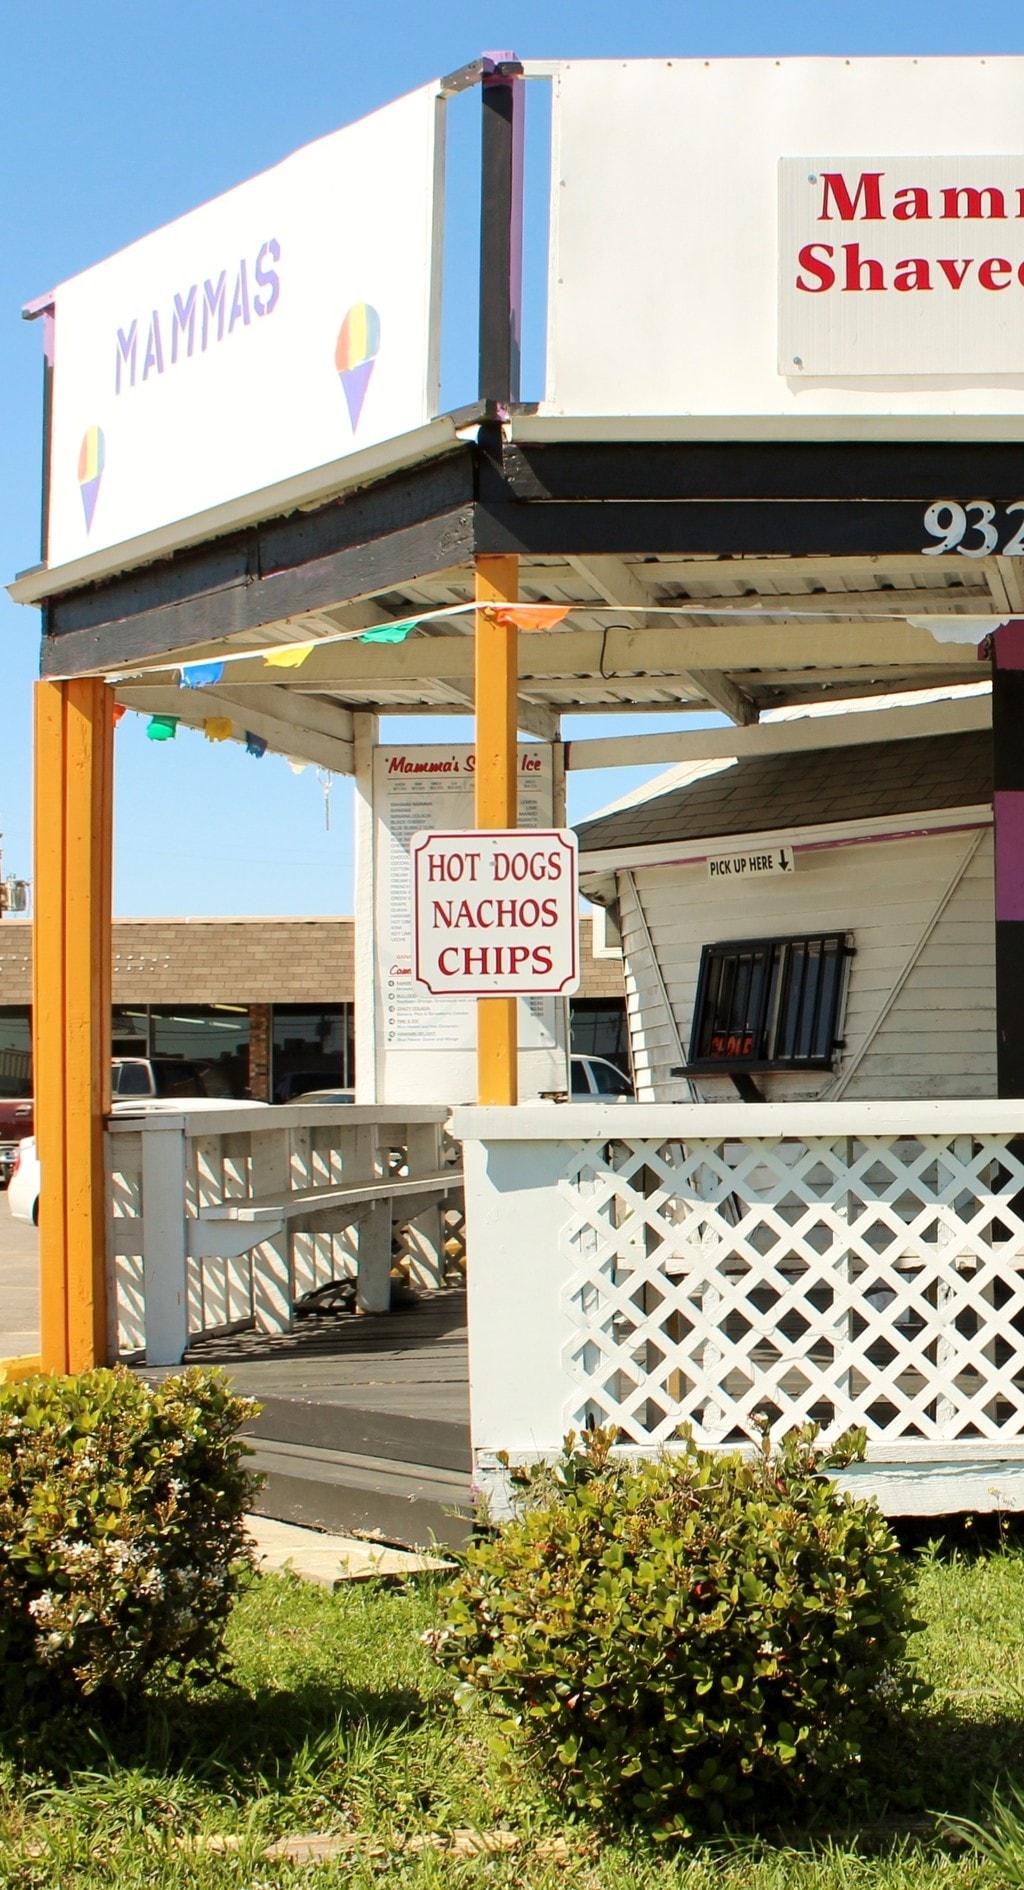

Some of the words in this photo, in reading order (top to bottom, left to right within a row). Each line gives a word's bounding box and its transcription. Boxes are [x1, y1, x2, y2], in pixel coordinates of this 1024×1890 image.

[115, 237, 281, 395] MAMMAS
[388, 755, 460, 774] Mamma's
[521, 753, 542, 771] Ice
[427, 853, 481, 882] HOT
[492, 851, 562, 882] DOGS
[710, 860, 732, 876] PICK
[733, 858, 747, 873] UP
[749, 855, 774, 872] HERE
[432, 898, 558, 929] NACHOS
[437, 946, 553, 976] CHIPS
